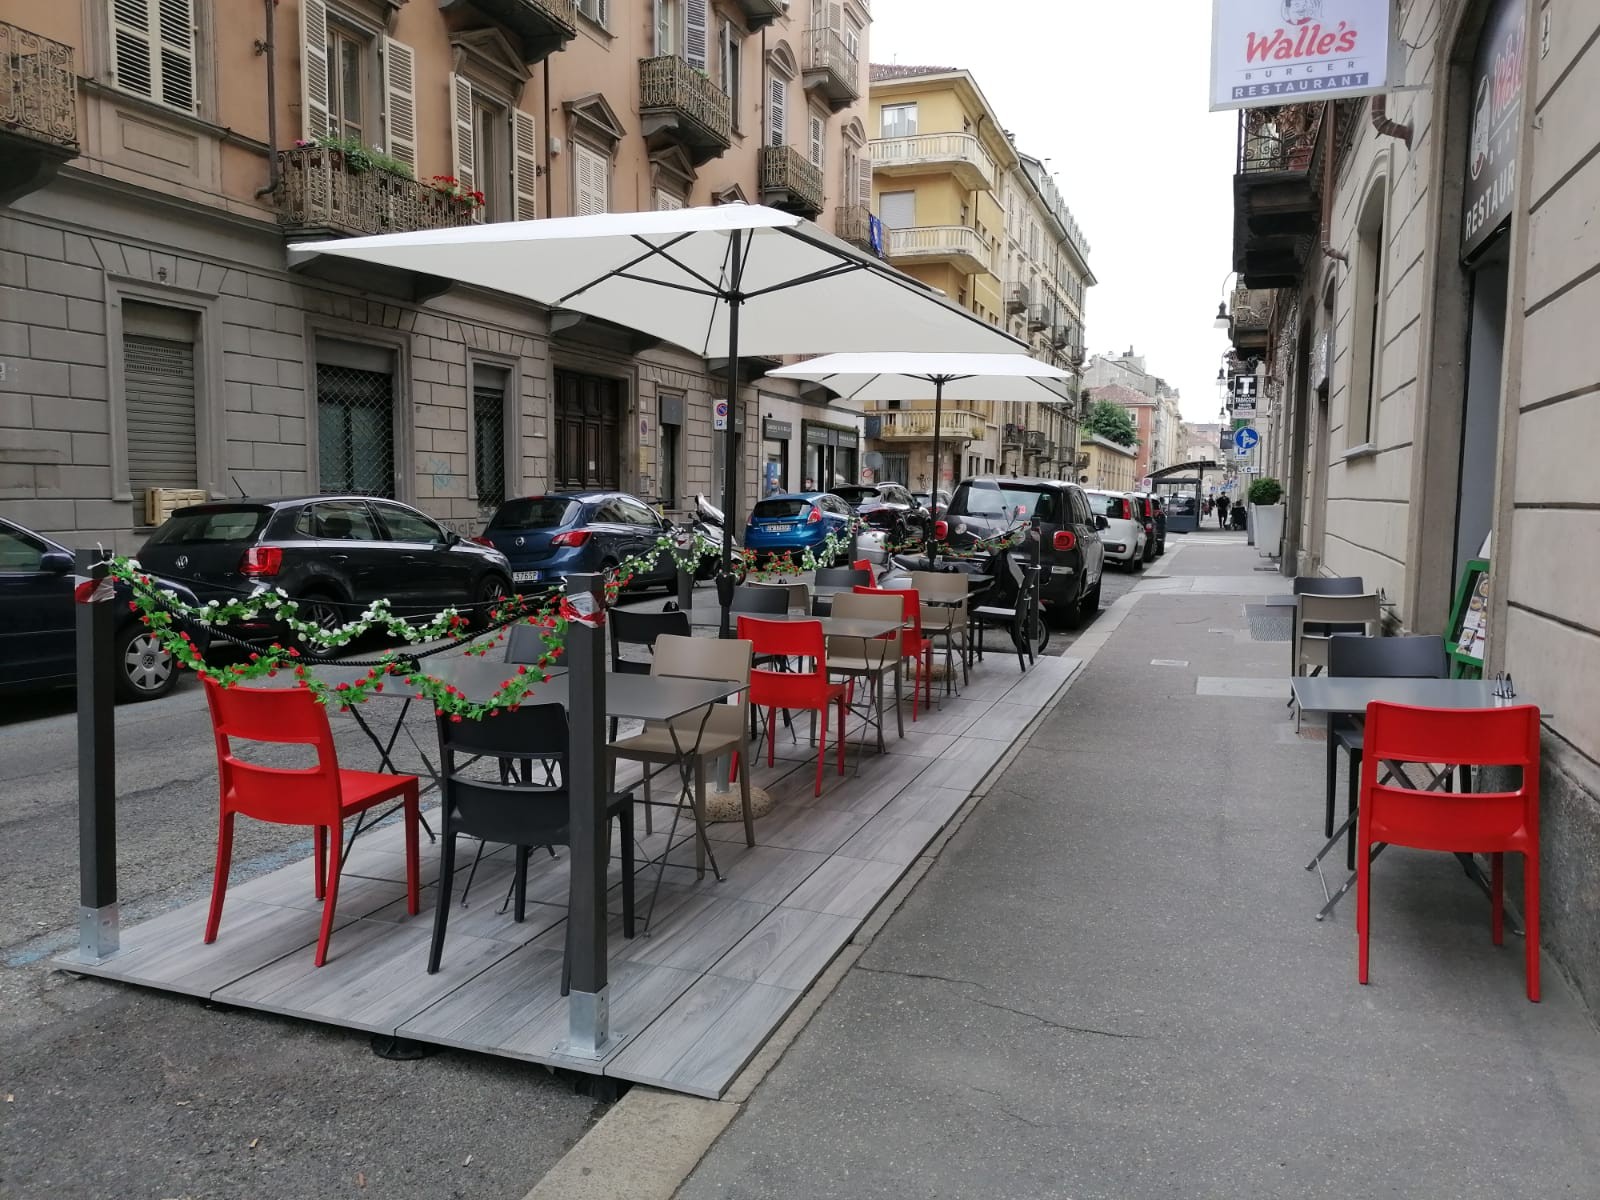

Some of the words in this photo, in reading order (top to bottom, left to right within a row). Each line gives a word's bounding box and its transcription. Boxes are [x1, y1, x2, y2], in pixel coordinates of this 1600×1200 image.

[1246, 20, 1358, 64] Walle's
[1245, 61, 1355, 80] BURGER
[1234, 74, 1364, 98] RESTAURANT
[1239, 377, 1254, 394] T
